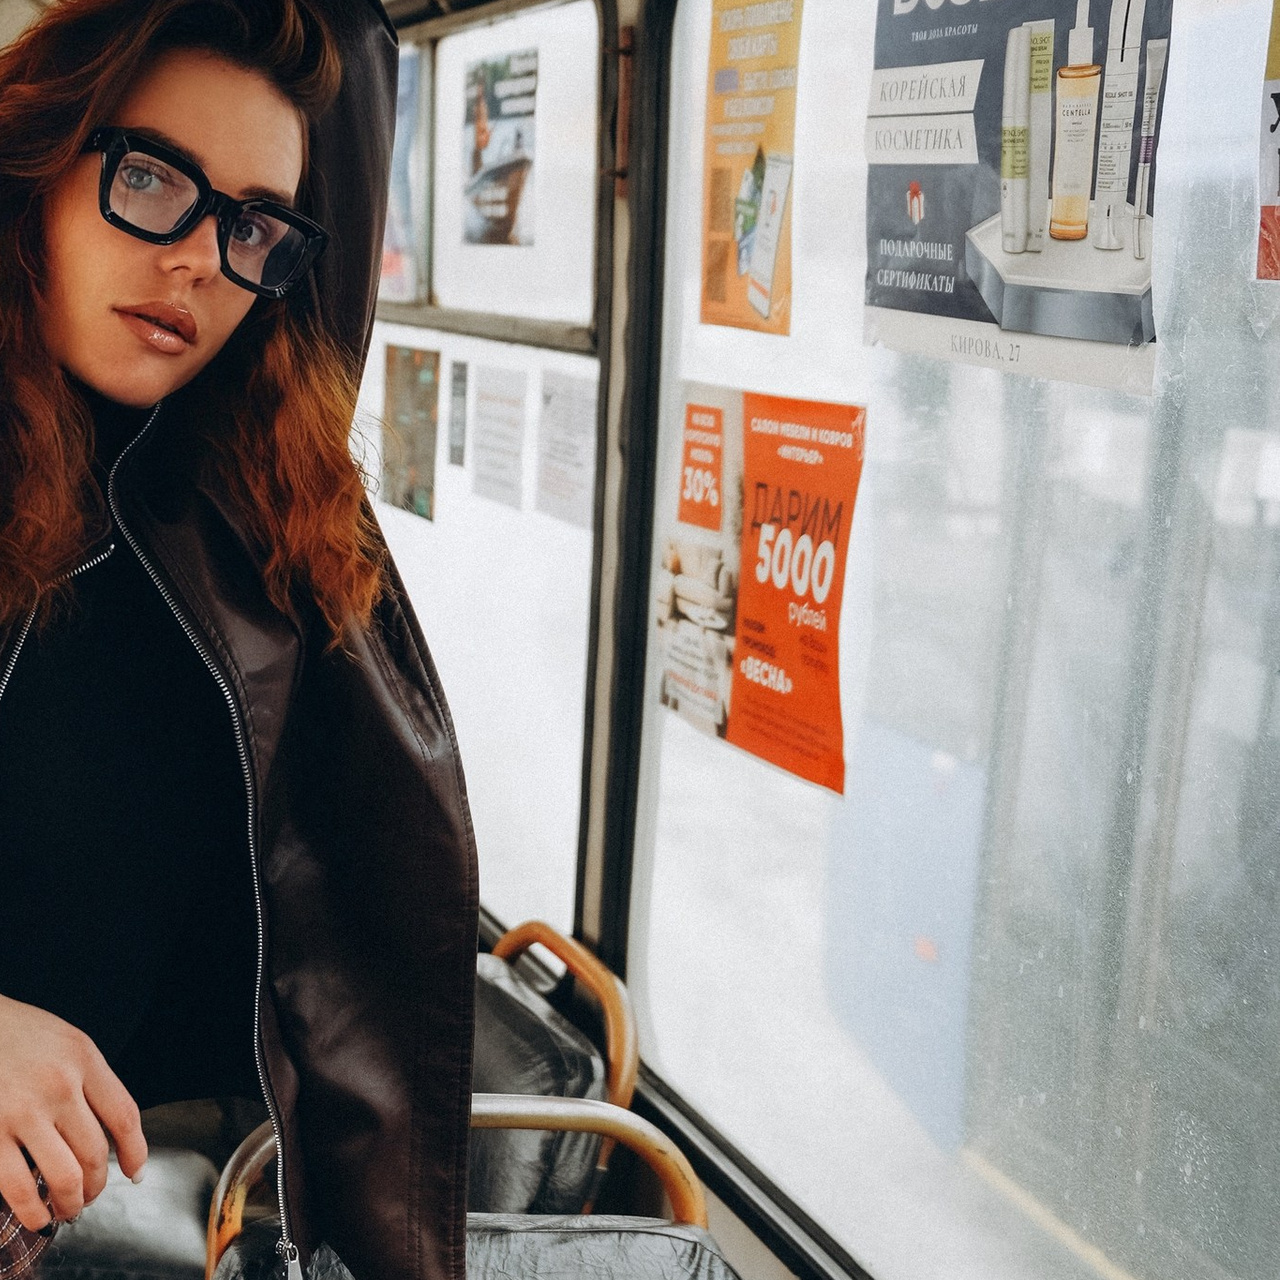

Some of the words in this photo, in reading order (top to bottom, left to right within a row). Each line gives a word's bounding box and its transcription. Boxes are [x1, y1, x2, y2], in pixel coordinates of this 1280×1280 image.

[944, 24, 978, 37] КРАСОТЫ
[880, 74, 967, 102] КОРЕЙСКАЯ
[1062, 109, 1091, 117] CENTELLA
[874, 128, 964, 151] КОСМЕТИКА
[880, 238, 954, 262] ПОДАРОЧНЫЕ
[877, 269, 956, 294] СЕРТИФИКАТЫ
[951, 334, 1005, 363] КИРОВА,
[1008, 343, 1021, 363] 27
[683, 466, 719, 508] 30%
[750, 481, 844, 552] ДАРИМ
[755, 523, 835, 604] 5000
[740, 655, 794, 695] «ВЕСНА»
